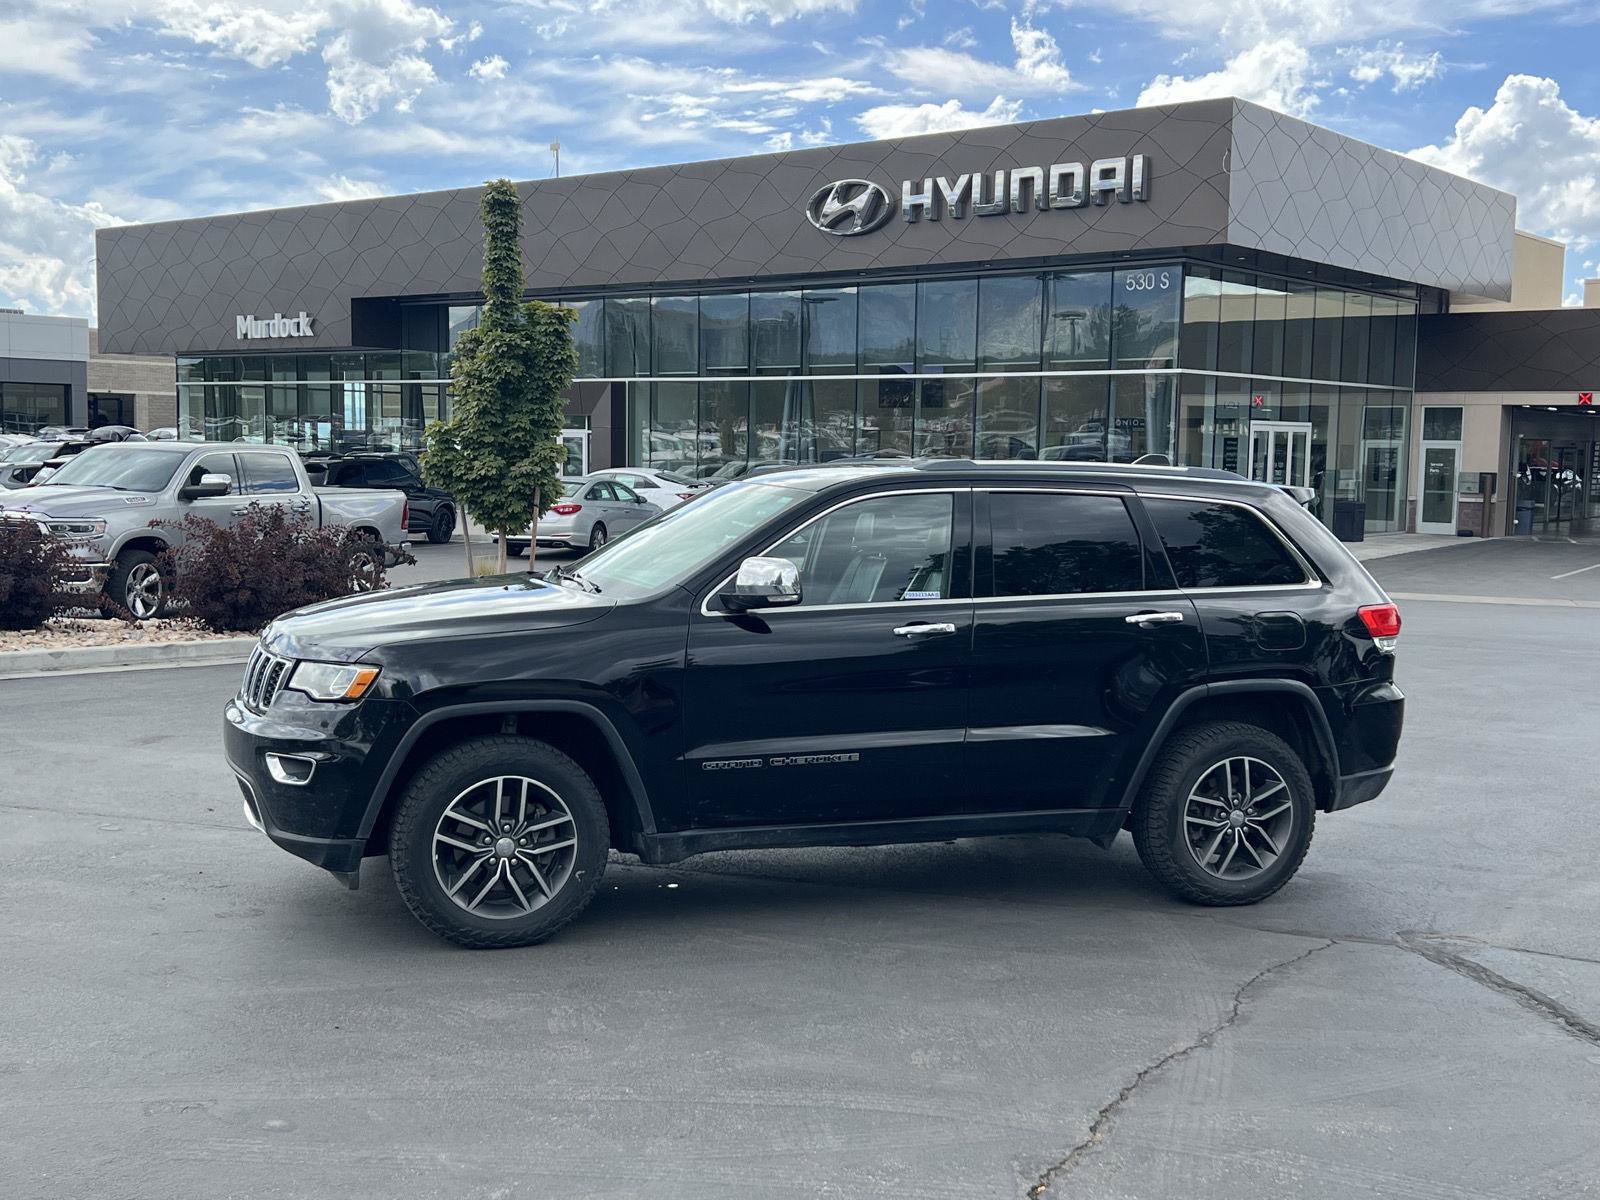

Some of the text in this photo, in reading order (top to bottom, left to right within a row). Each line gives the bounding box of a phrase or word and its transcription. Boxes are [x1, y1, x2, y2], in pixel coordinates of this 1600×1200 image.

[902, 154, 1147, 223] HYUNDAI
[1126, 272, 1169, 290] 530 S
[236, 311, 314, 339] Murdock
[702, 753, 860, 770] GRAND CHEROKEE
